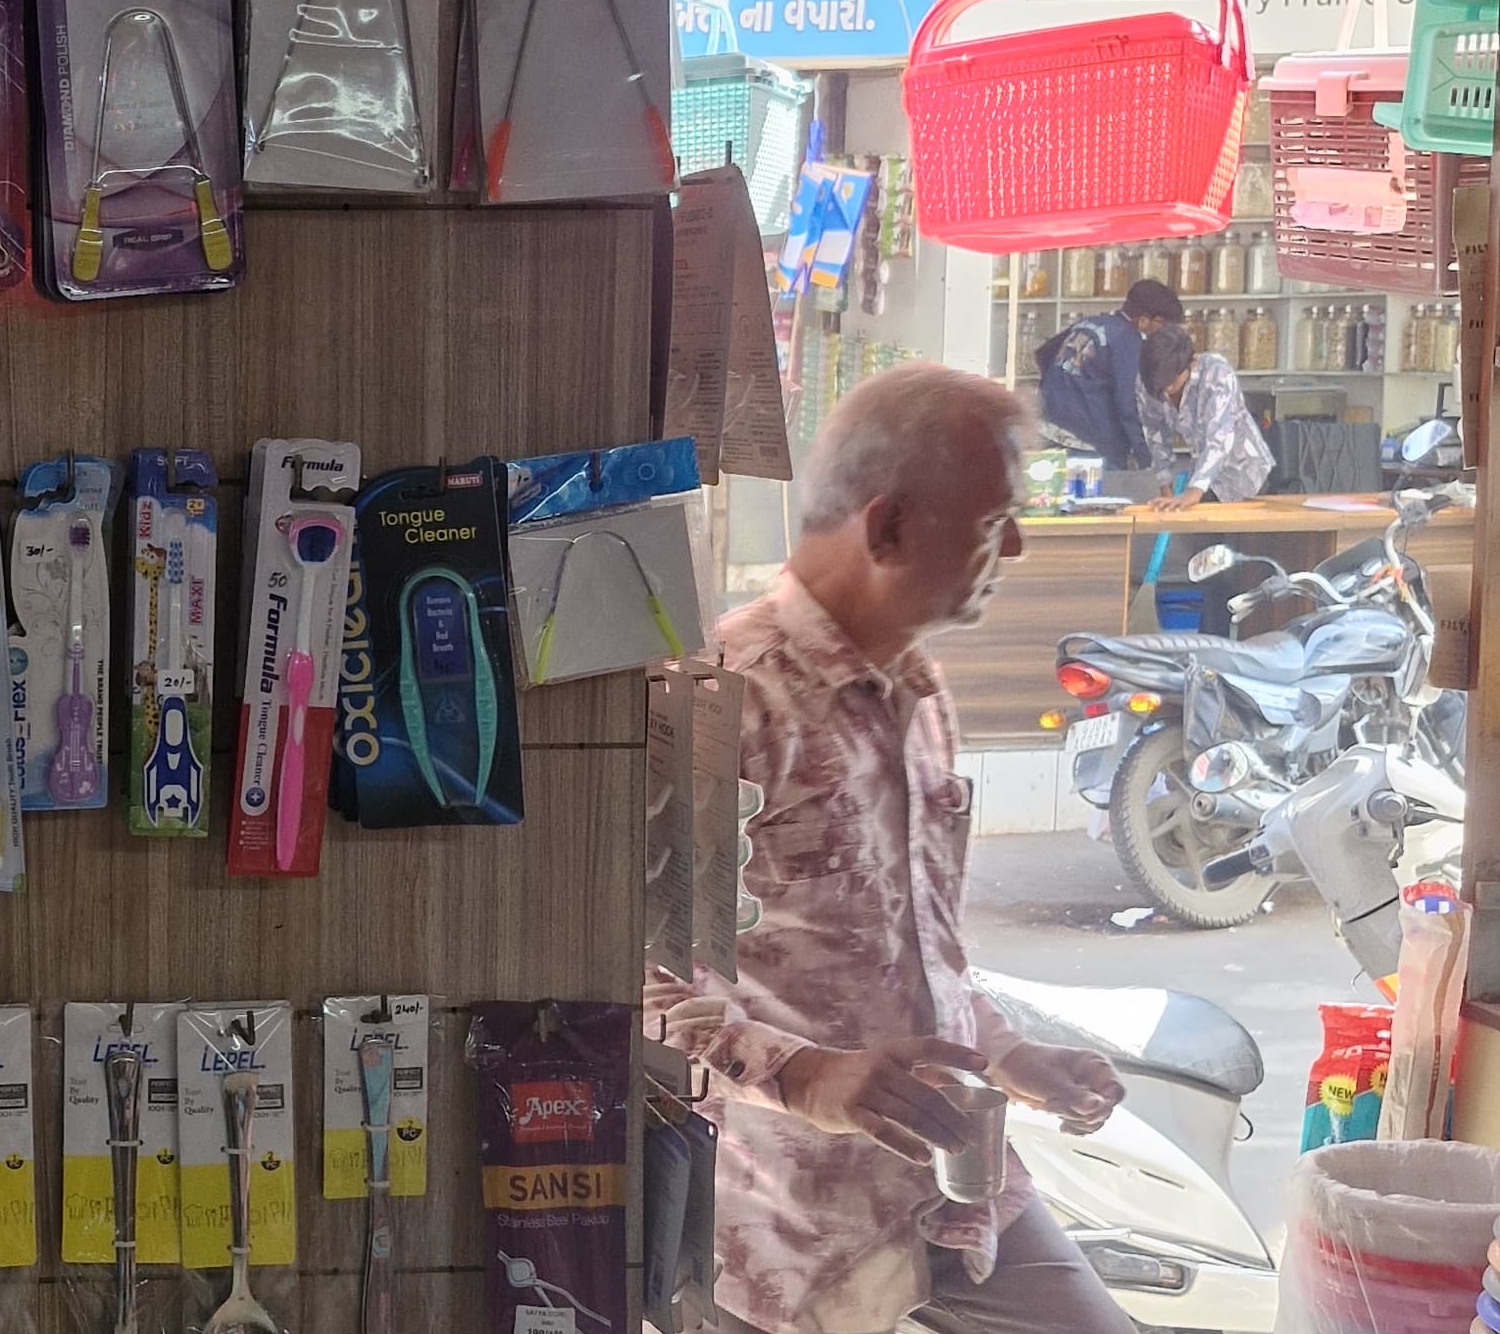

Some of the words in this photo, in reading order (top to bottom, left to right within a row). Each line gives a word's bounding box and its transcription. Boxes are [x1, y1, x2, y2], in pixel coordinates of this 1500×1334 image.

[56, 22, 69, 75] POLISH
[60, 77, 74, 151] DIAMOND
[139, 501, 151, 538] Kidz
[378, 509, 444, 527] Tongue
[405, 526, 476, 544] Cleaner
[26, 544, 53, 558] 30/-
[267, 571, 287, 587] 50
[190, 580, 204, 625] MAXI
[261, 593, 288, 693] Formula
[165, 677, 192, 687] 20/-
[261, 700, 271, 736] Tongue
[395, 1003, 423, 1015] 240/-
[1327, 1084, 1354, 1098] NEW
[519, 1096, 590, 1126] Apex
[509, 1172, 601, 1202] SANSI
